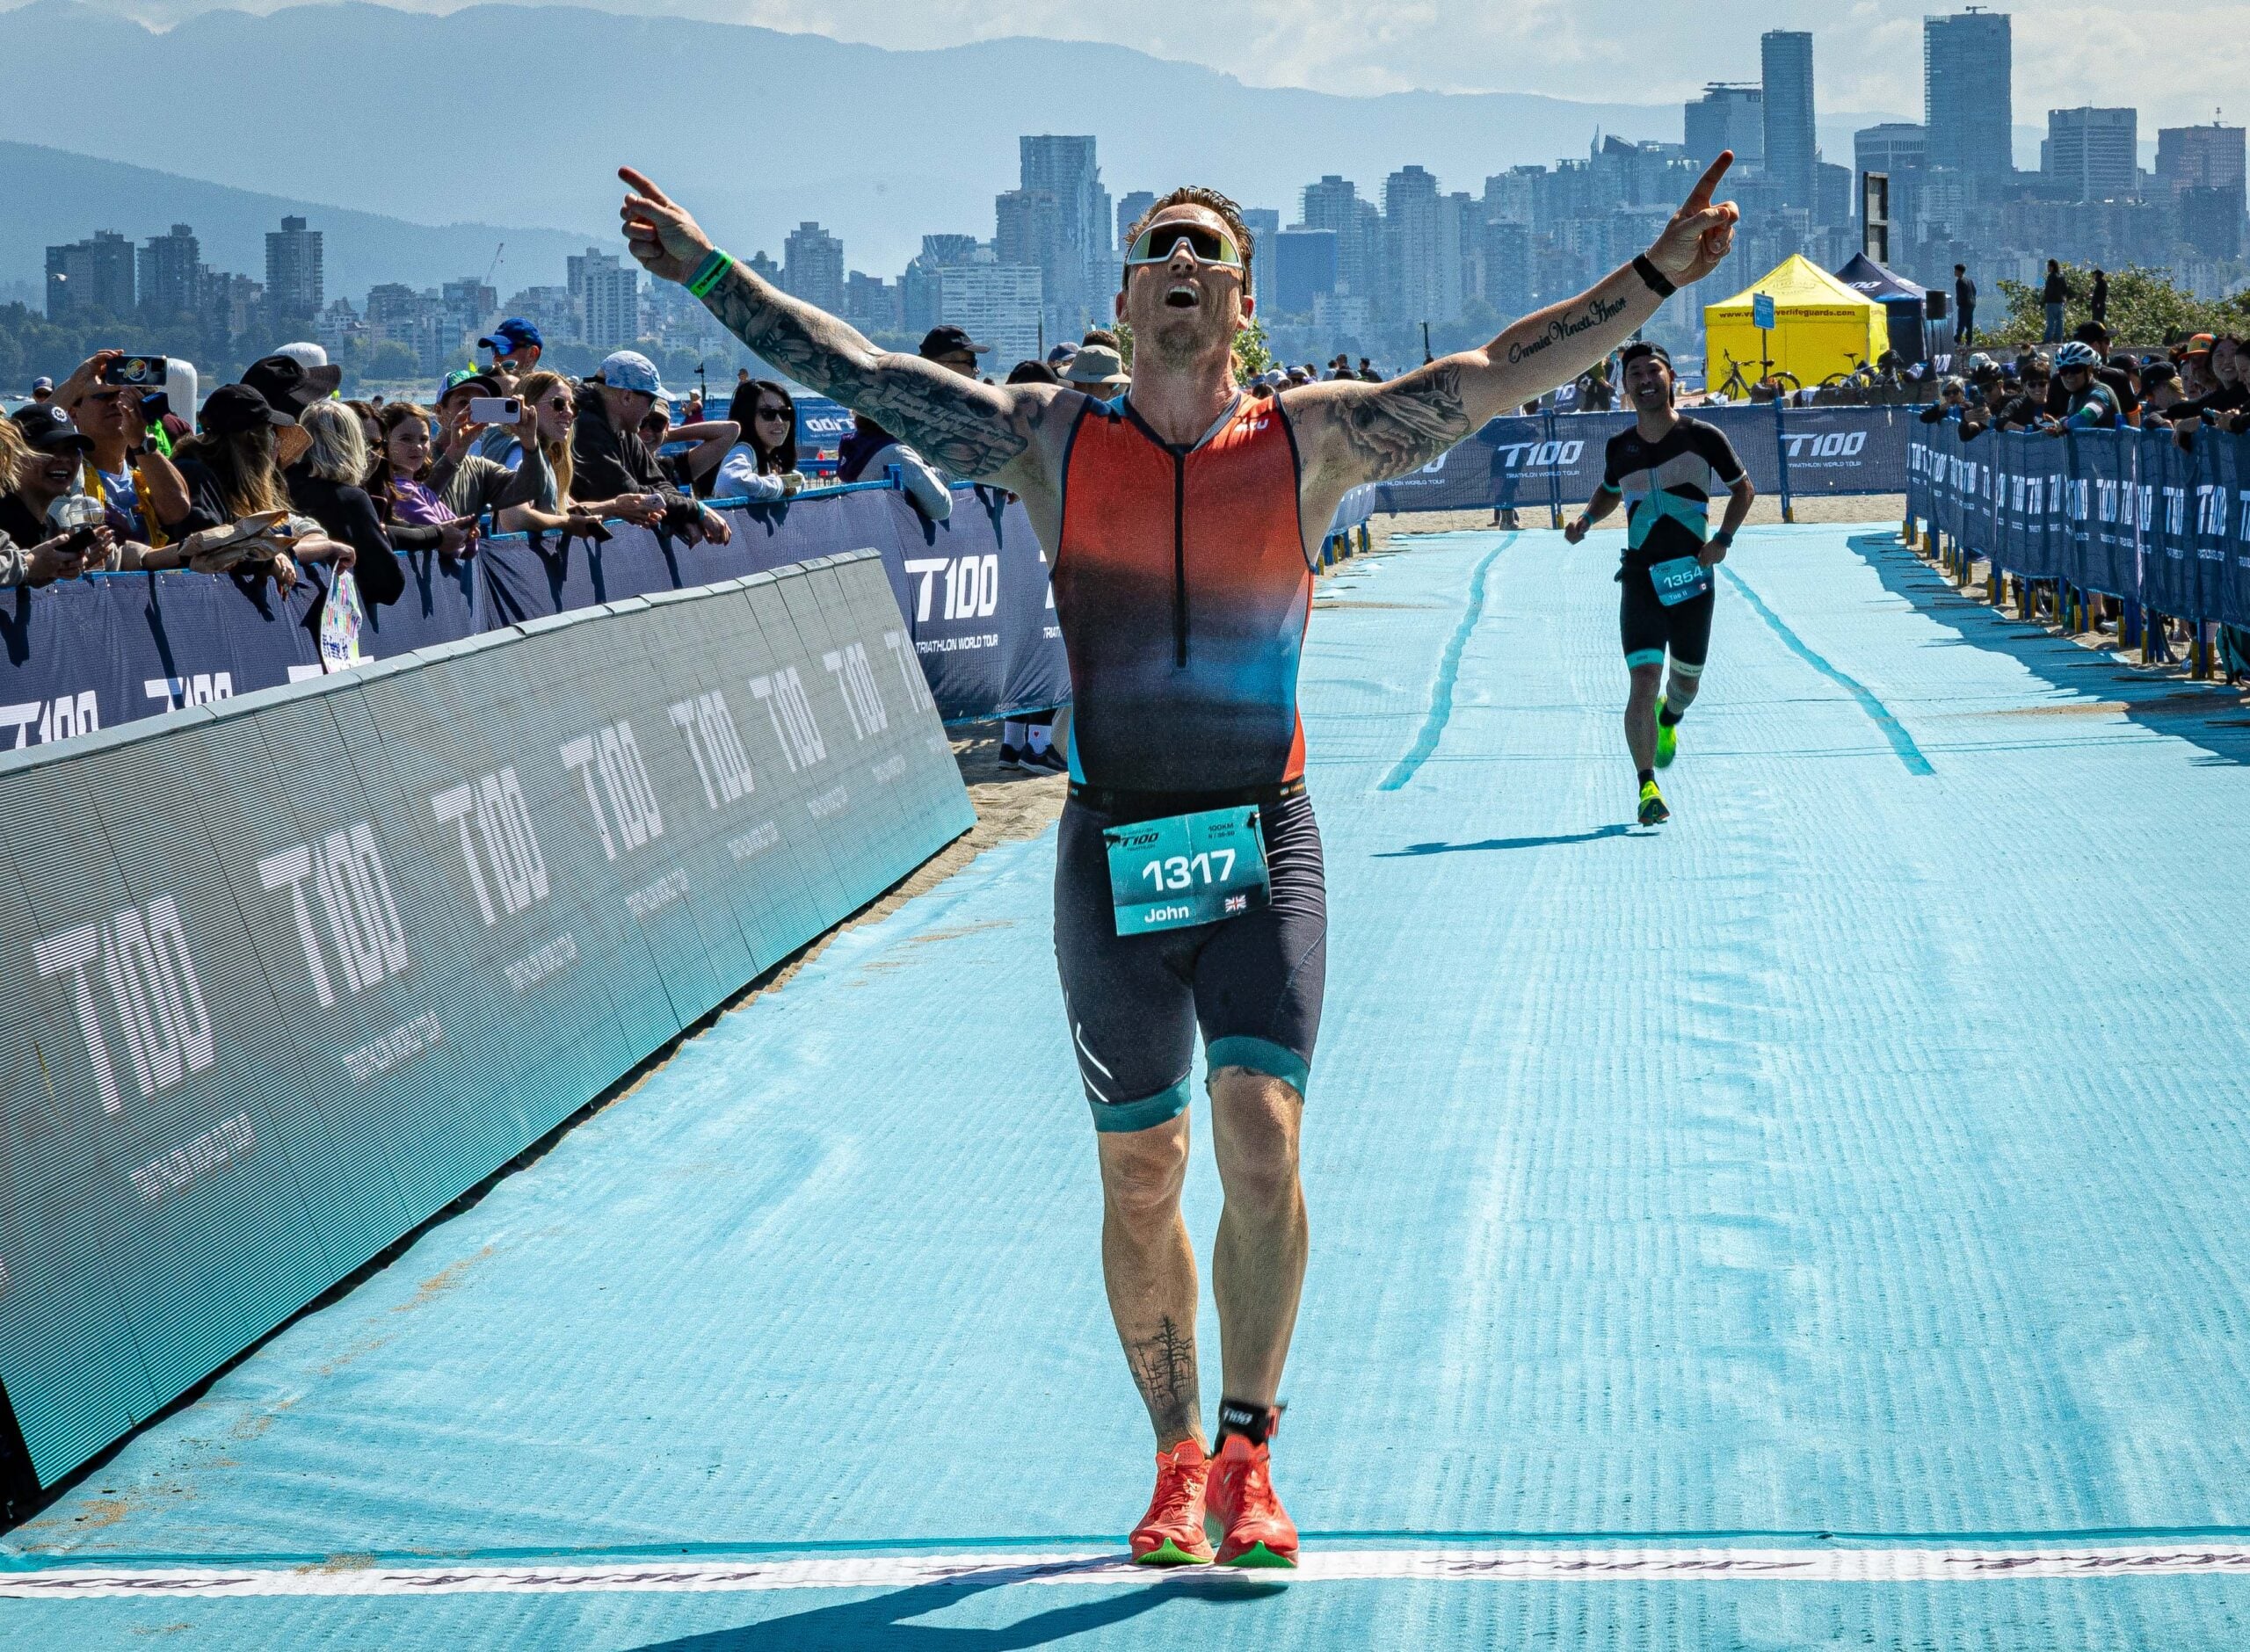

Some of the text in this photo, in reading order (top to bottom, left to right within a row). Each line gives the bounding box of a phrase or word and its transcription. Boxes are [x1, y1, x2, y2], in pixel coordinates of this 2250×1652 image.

[1499, 440, 1585, 467] T100
[1780, 431, 1867, 457] T100
[904, 554, 998, 622] T100
[1664, 565, 1703, 588] 1354
[916, 634, 998, 654] TRIATHLON WORLD TOUR
[749, 666, 825, 772] T100
[824, 643, 886, 740] T100
[669, 691, 755, 809] T100
[561, 718, 664, 860] T100
[432, 767, 549, 927] T100
[1121, 832, 1159, 847] T100
[1143, 848, 1236, 891] 1317
[258, 822, 409, 1008] T100
[1144, 906, 1189, 923] John
[33, 896, 214, 1113] T100
